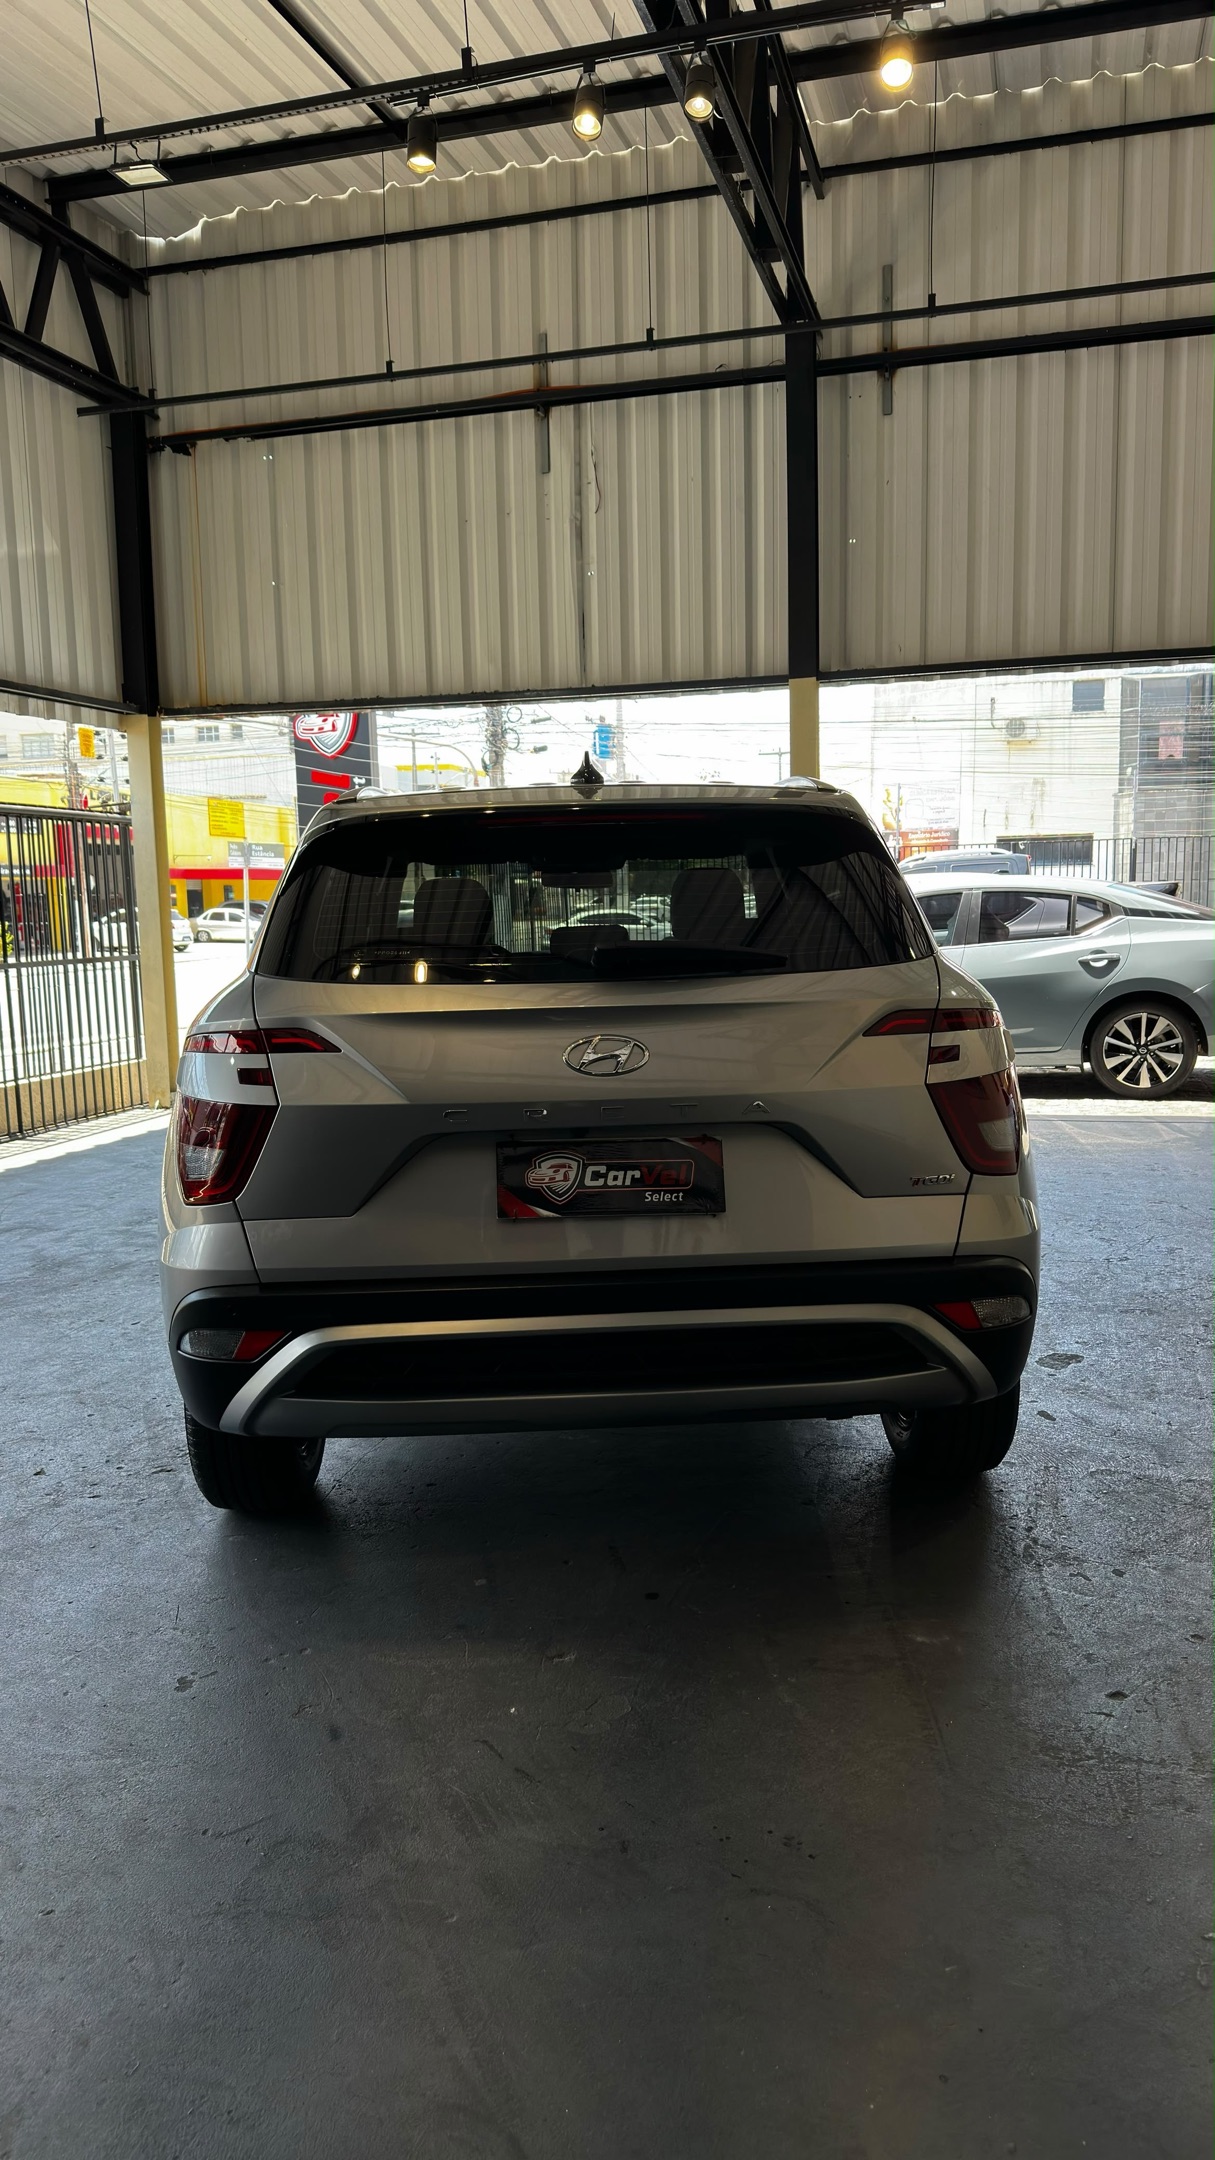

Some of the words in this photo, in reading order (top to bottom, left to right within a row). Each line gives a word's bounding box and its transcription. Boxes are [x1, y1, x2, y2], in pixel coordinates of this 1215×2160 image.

[443, 1101, 771, 1121] CRETA
[584, 1163, 688, 1187] CarVel
[644, 1191, 684, 1201] Select
